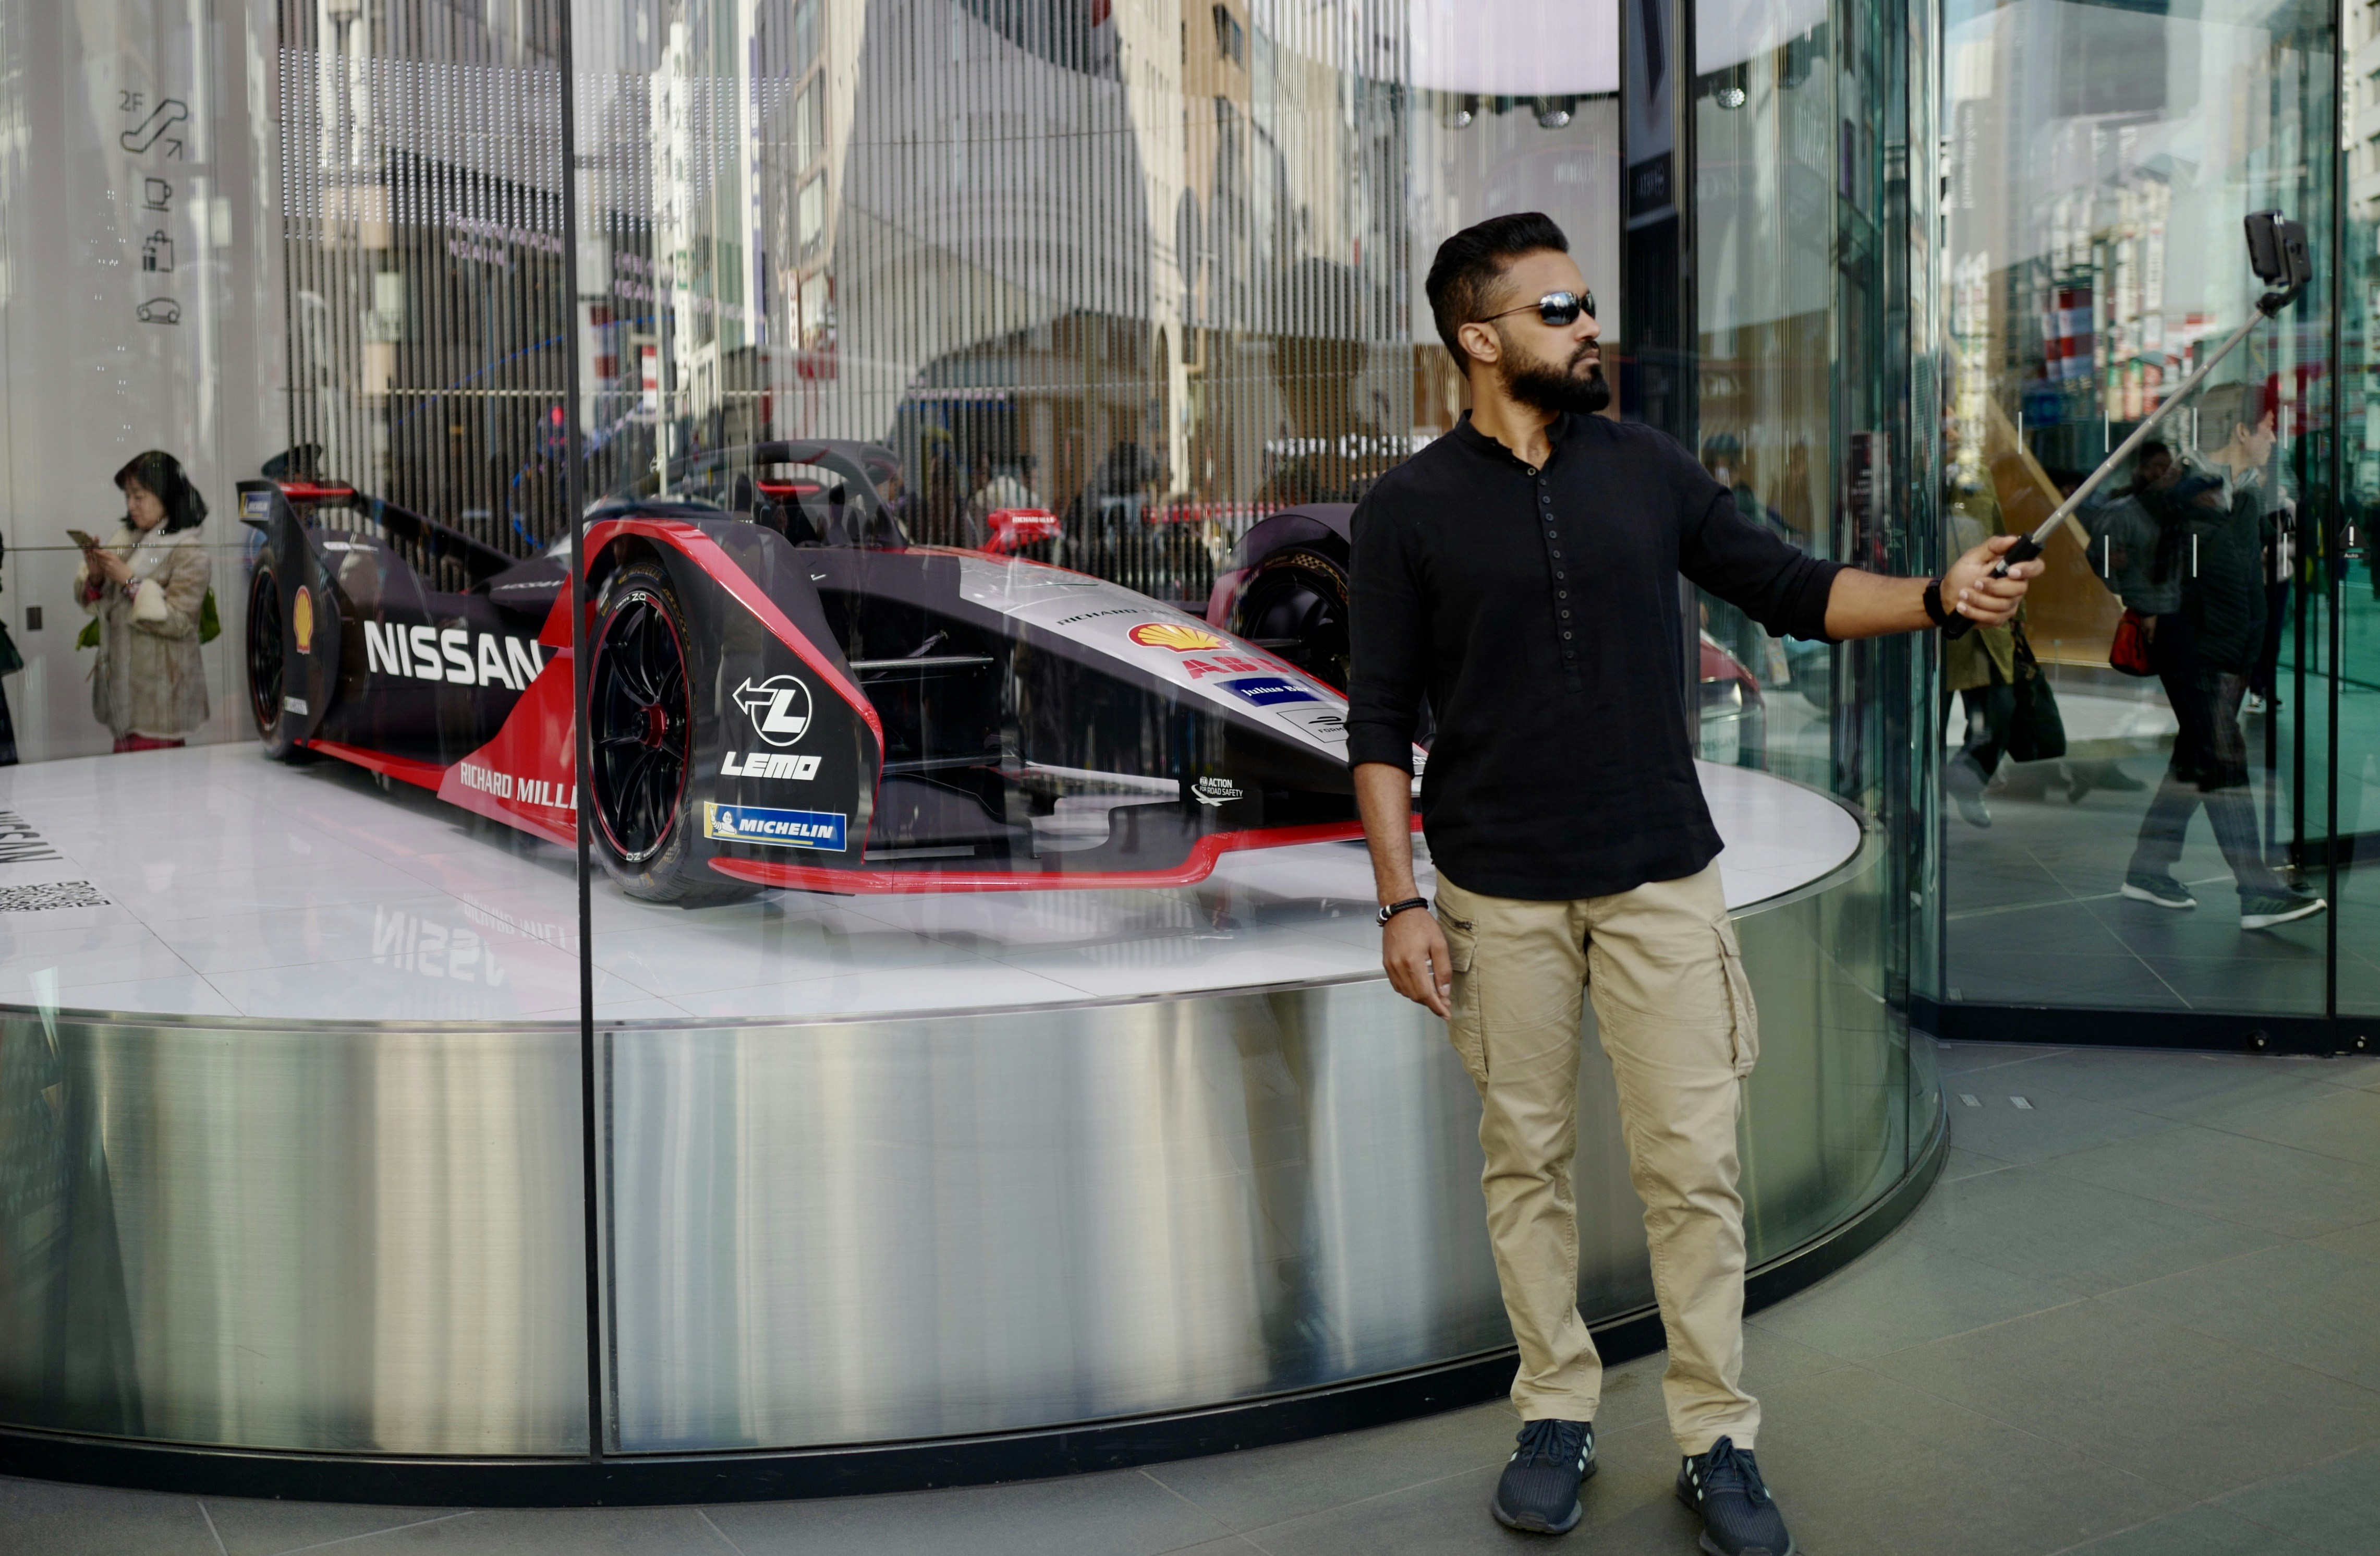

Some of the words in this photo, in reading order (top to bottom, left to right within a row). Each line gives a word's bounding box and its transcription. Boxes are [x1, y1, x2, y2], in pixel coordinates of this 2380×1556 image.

[119, 89, 142, 113] 2F
[1056, 609, 1138, 625] RICHARD
[364, 620, 544, 691] NISSAN
[1182, 656, 1290, 680] ABB
[1241, 685, 1284, 697] Julius
[721, 751, 822, 780] LEMO
[460, 761, 513, 799] RICHARD
[1208, 778, 1232, 789] ACTION
[1222, 788, 1243, 797] SAFETY
[739, 818, 833, 839] MICHELIN
[643, 843, 658, 858] RACING
